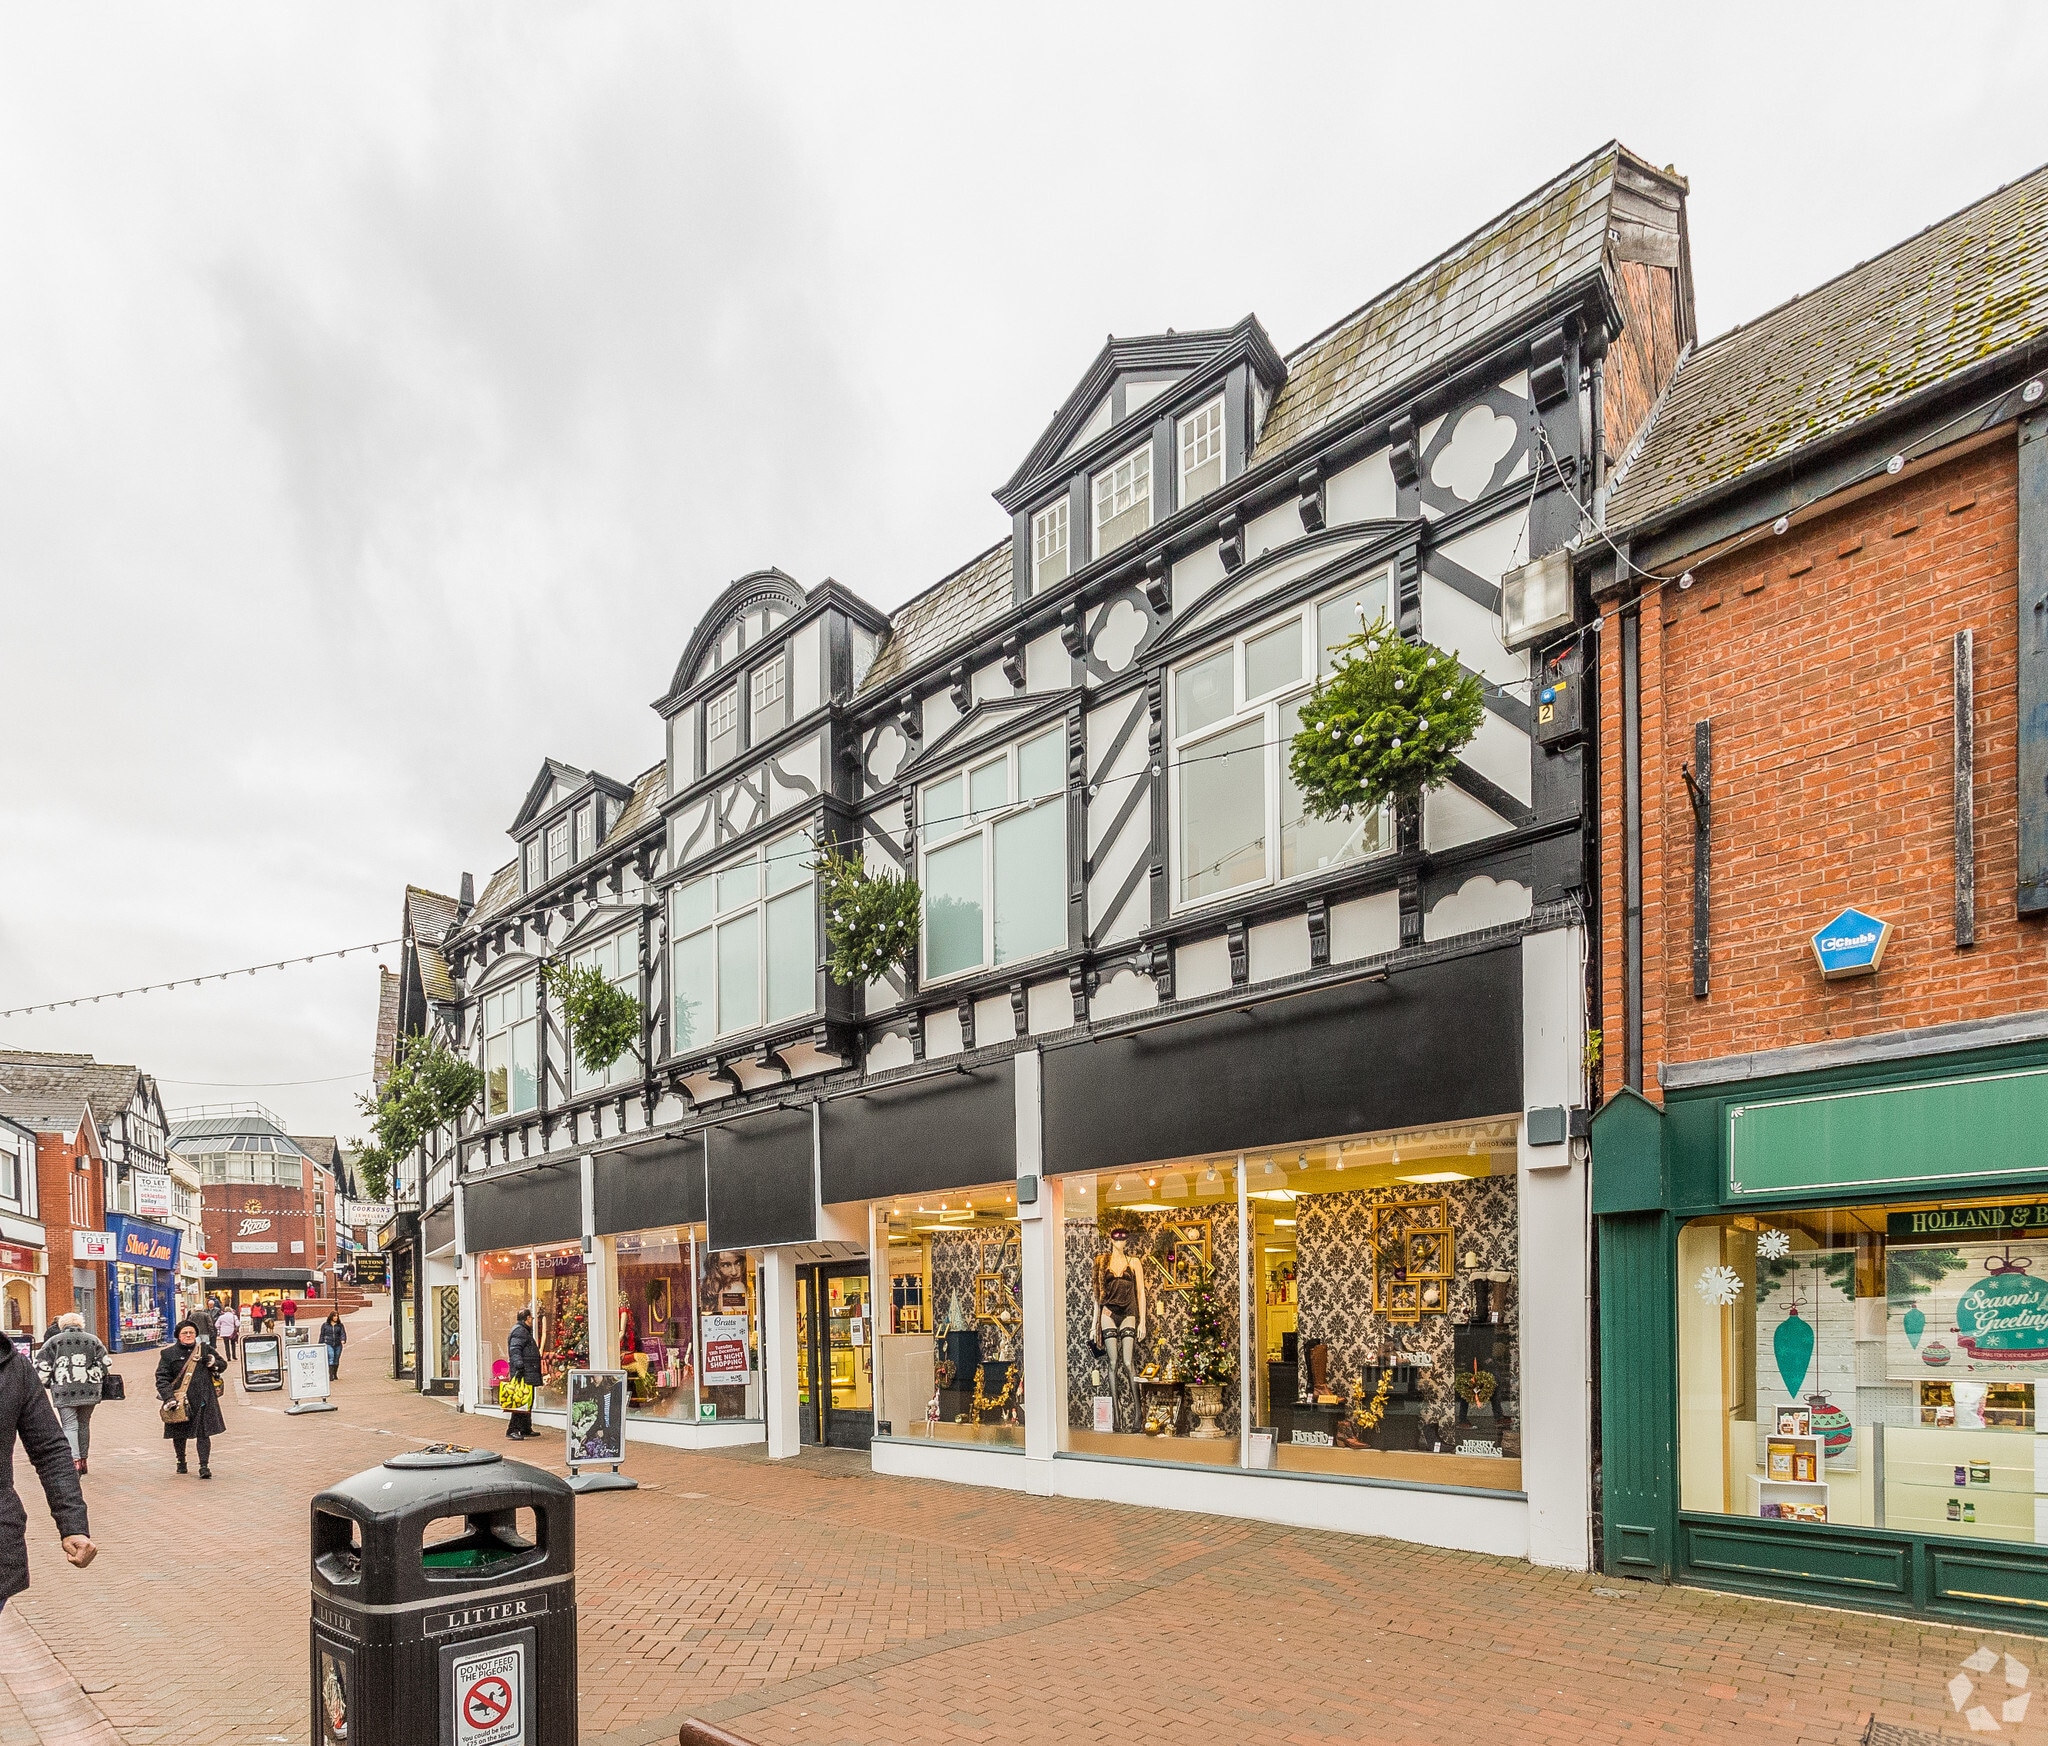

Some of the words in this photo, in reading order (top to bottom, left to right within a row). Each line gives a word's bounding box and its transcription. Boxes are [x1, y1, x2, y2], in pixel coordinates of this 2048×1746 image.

[1541, 706, 1551, 720] 2
[1835, 932, 1876, 948] Chubb
[237, 1218, 271, 1236] Boots
[1911, 1208, 2006, 1233] HOLLAND
[2010, 1206, 2030, 1228] &
[81, 1236, 93, 1244] TO
[125, 1233, 149, 1256] Shoe
[148, 1238, 172, 1260] Zone
[1964, 1289, 2040, 1311] Season's
[707, 1355, 723, 1363] LATE
[723, 1351, 744, 1361] NIGHT
[710, 1358, 743, 1369] SHOPPING
[1462, 1439, 1496, 1448] MERRY
[320, 1605, 352, 1632] LITTER
[447, 1600, 528, 1628] LITTER
[460, 1666, 474, 1676] DO
[475, 1661, 493, 1670] NOT
[493, 1656, 514, 1667] FEED
[460, 1672, 477, 1683] THE
[478, 1664, 514, 1679] PIGEONS
[473, 1730, 491, 1739] could
[499, 1722, 515, 1732] fined
[498, 1730, 511, 1740] spot
